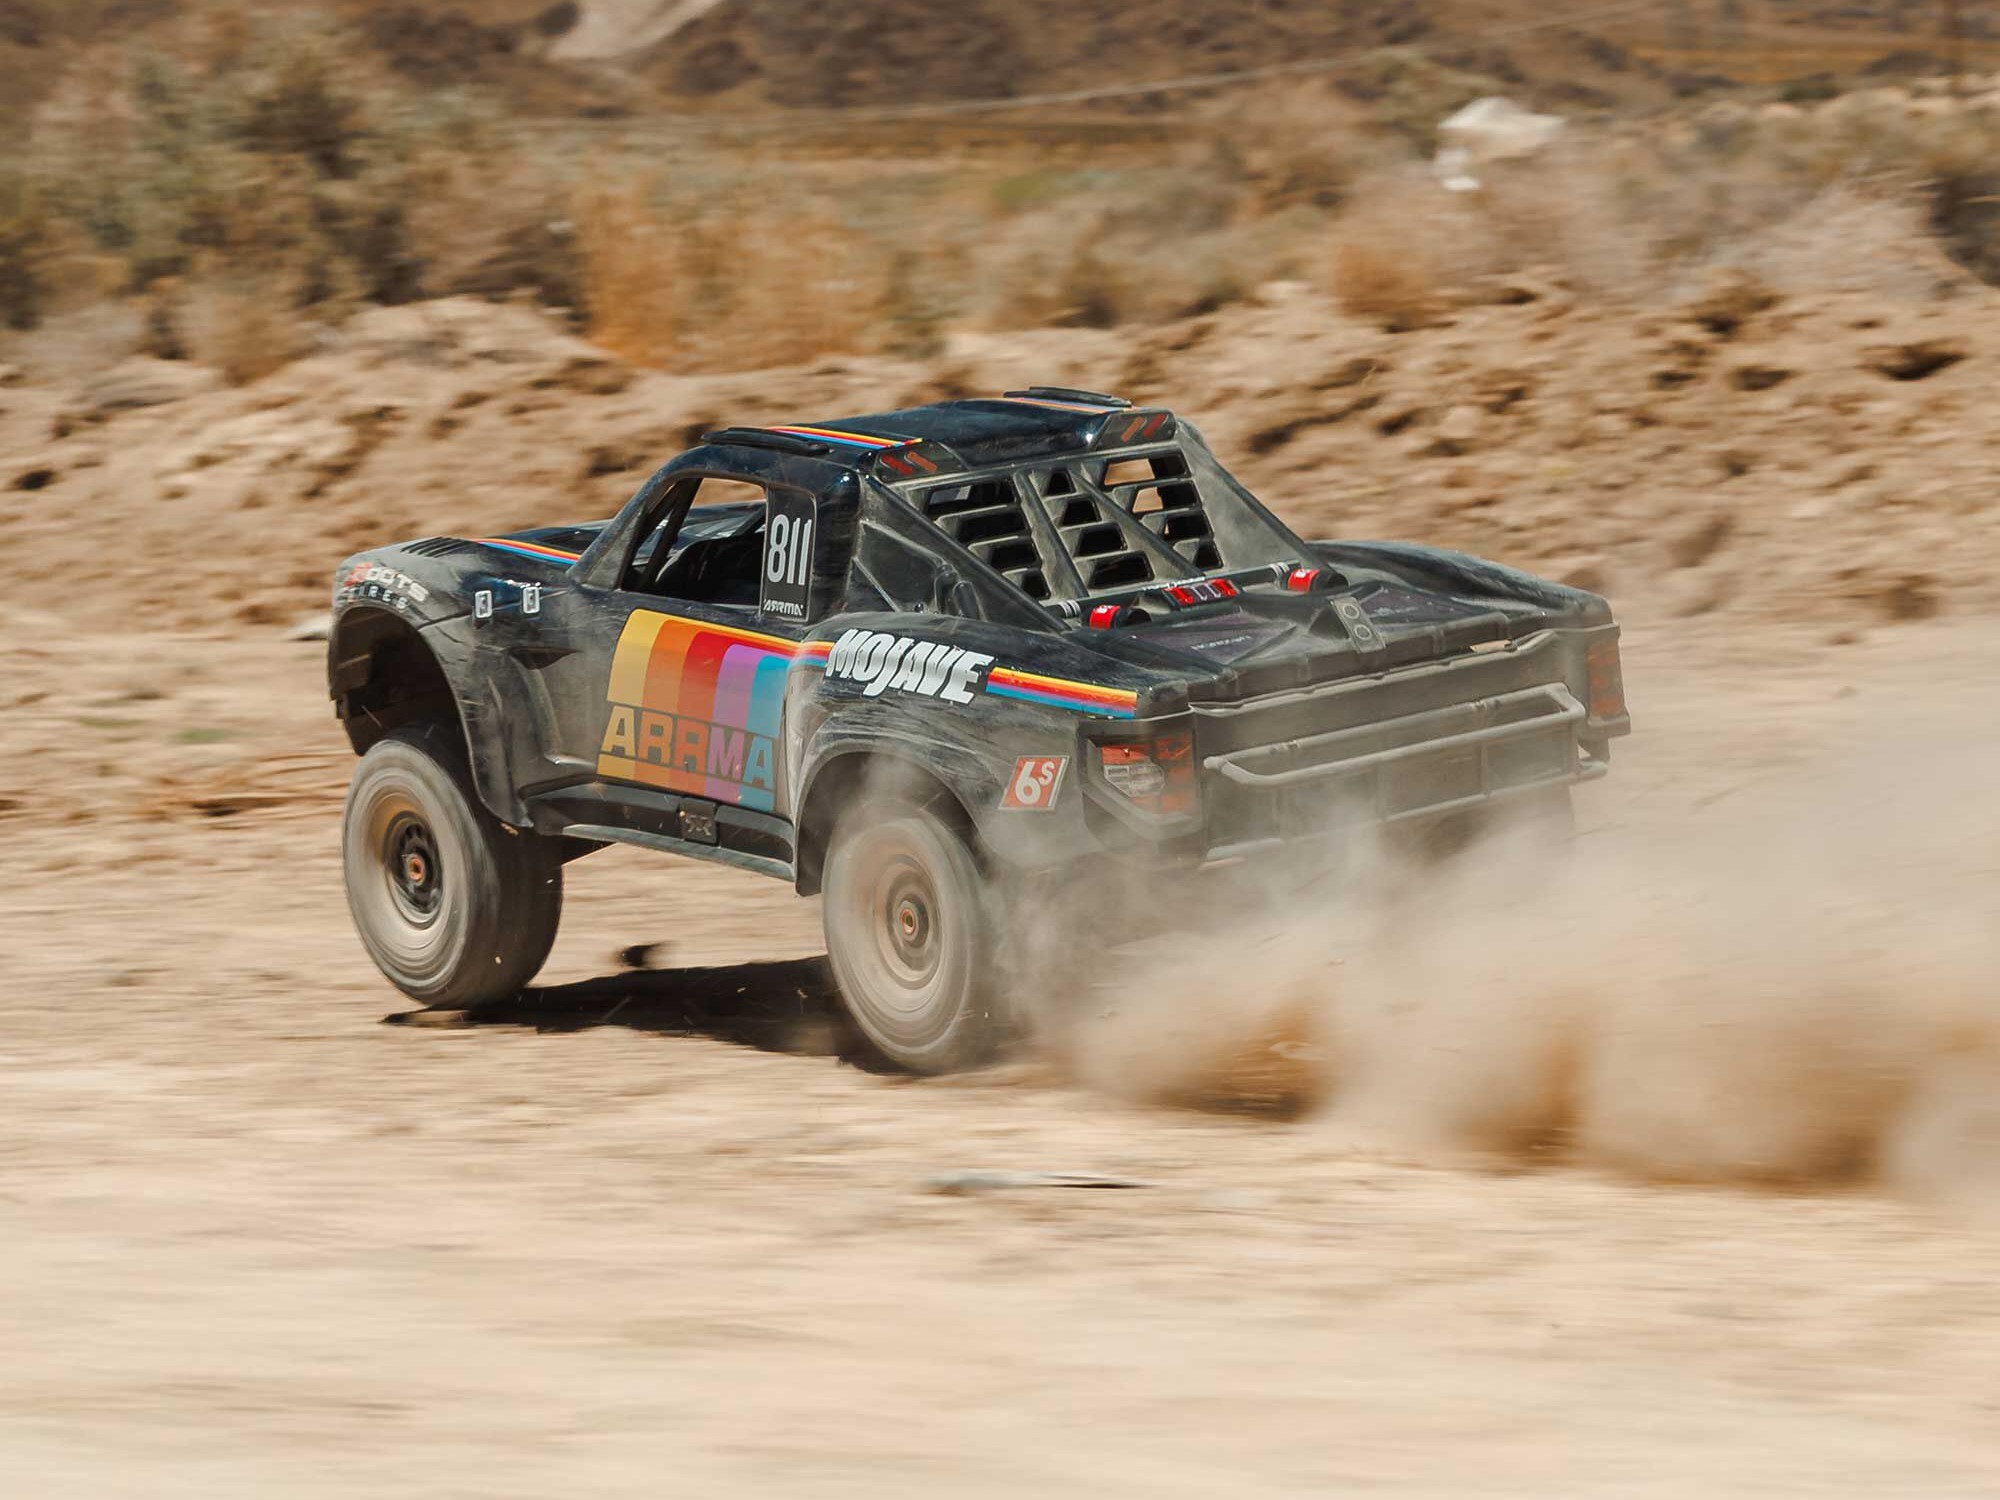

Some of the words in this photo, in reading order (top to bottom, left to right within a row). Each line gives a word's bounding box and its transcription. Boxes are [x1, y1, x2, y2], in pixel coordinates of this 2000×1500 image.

[767, 514, 812, 586] 811
[825, 628, 995, 704] MOJAVE
[600, 704, 774, 791] ARRMA
